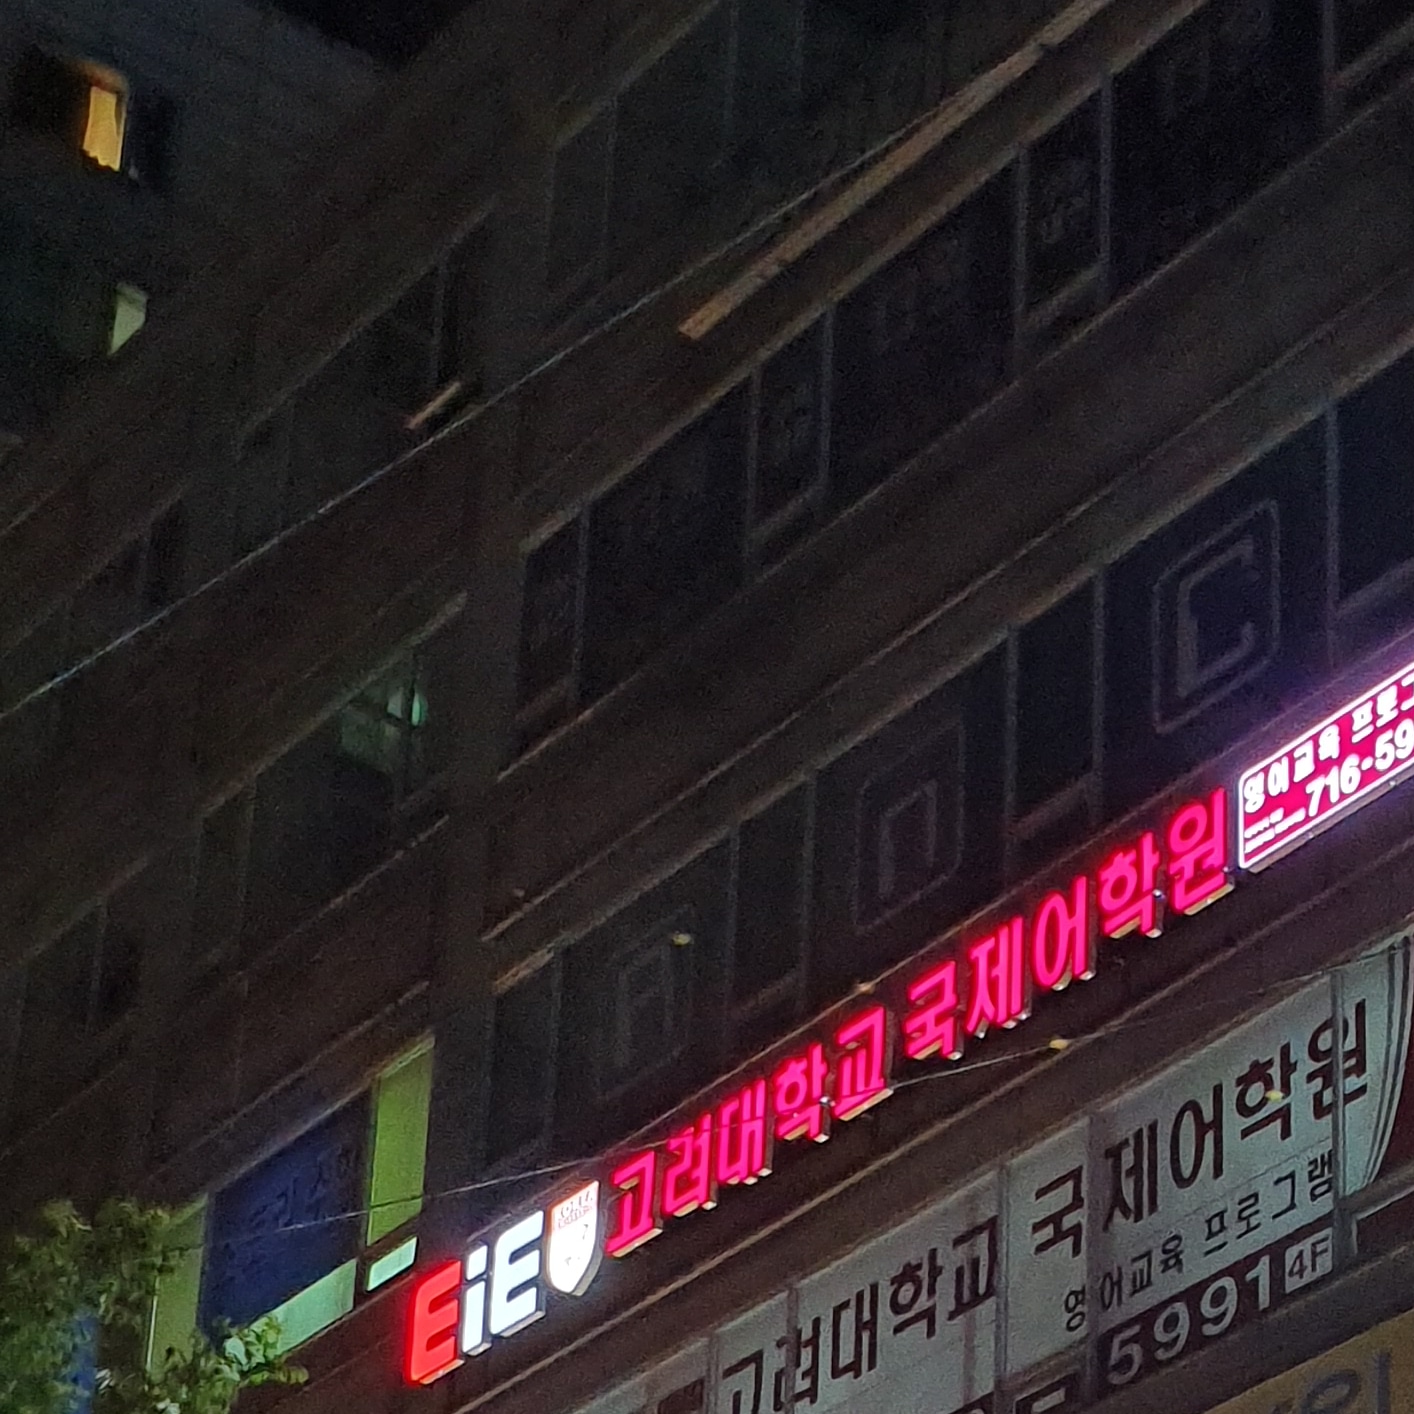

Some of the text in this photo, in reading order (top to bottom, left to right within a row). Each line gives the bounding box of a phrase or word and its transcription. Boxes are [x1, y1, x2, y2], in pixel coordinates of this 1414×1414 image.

[606, 1006, 886, 1256] 고려대학교
[904, 788, 1228, 1059] 국제어학원
[1031, 999, 1368, 1258] 국제어학원
[1065, 1229, 1184, 1332] 영어교육
[1287, 1234, 1330, 1281] 4F
